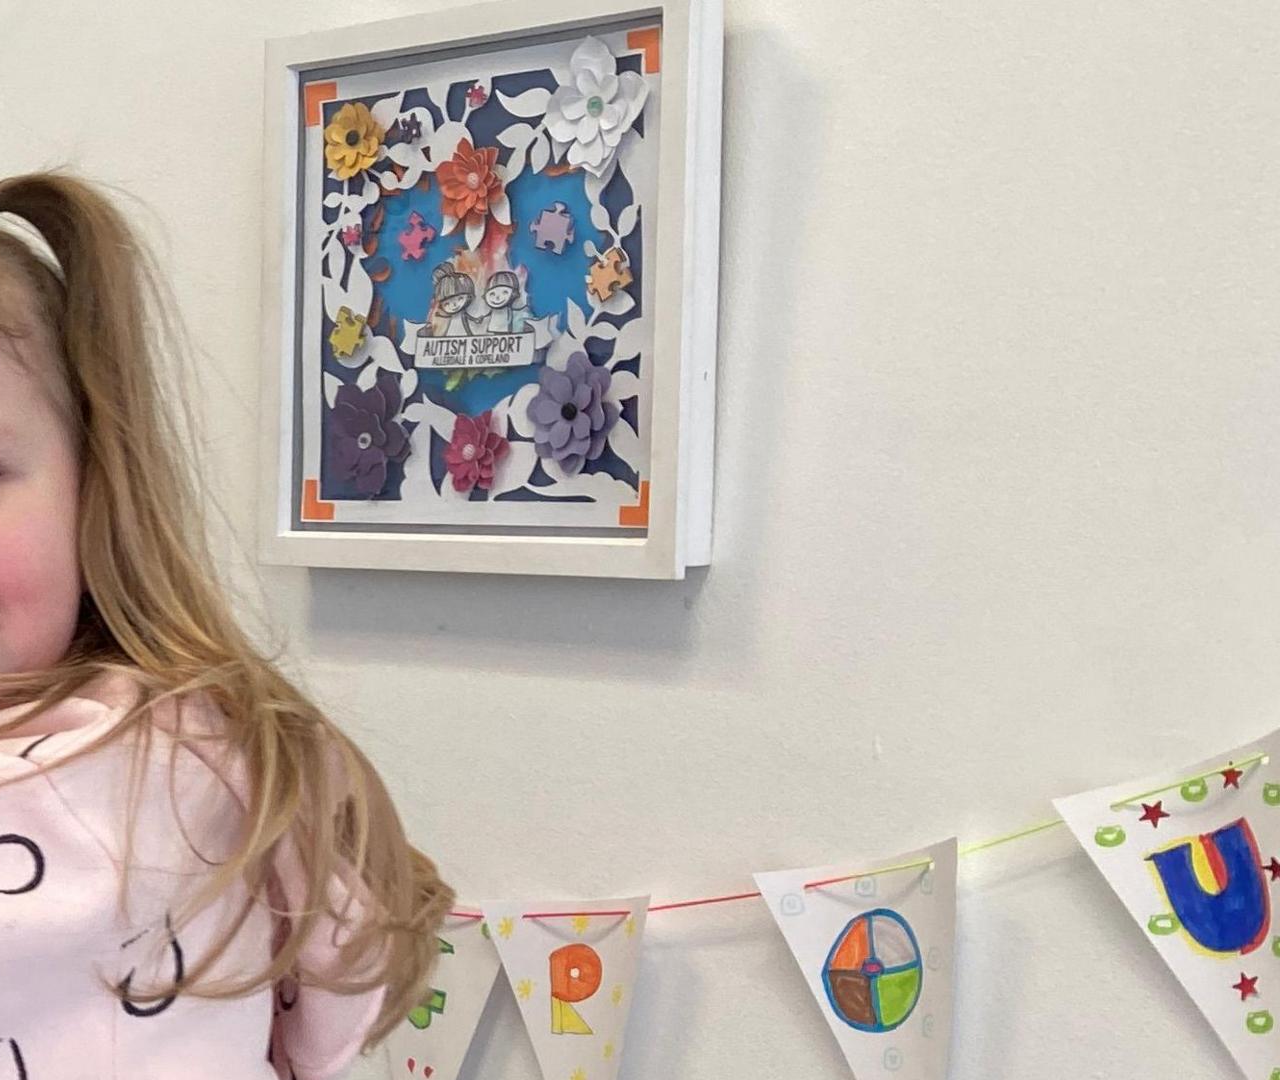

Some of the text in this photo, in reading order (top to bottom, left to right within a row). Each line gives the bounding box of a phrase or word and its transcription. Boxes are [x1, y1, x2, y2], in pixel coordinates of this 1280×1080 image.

[423, 336, 522, 357] AUTISM SUPPORT
[475, 353, 510, 364] COPELAND
